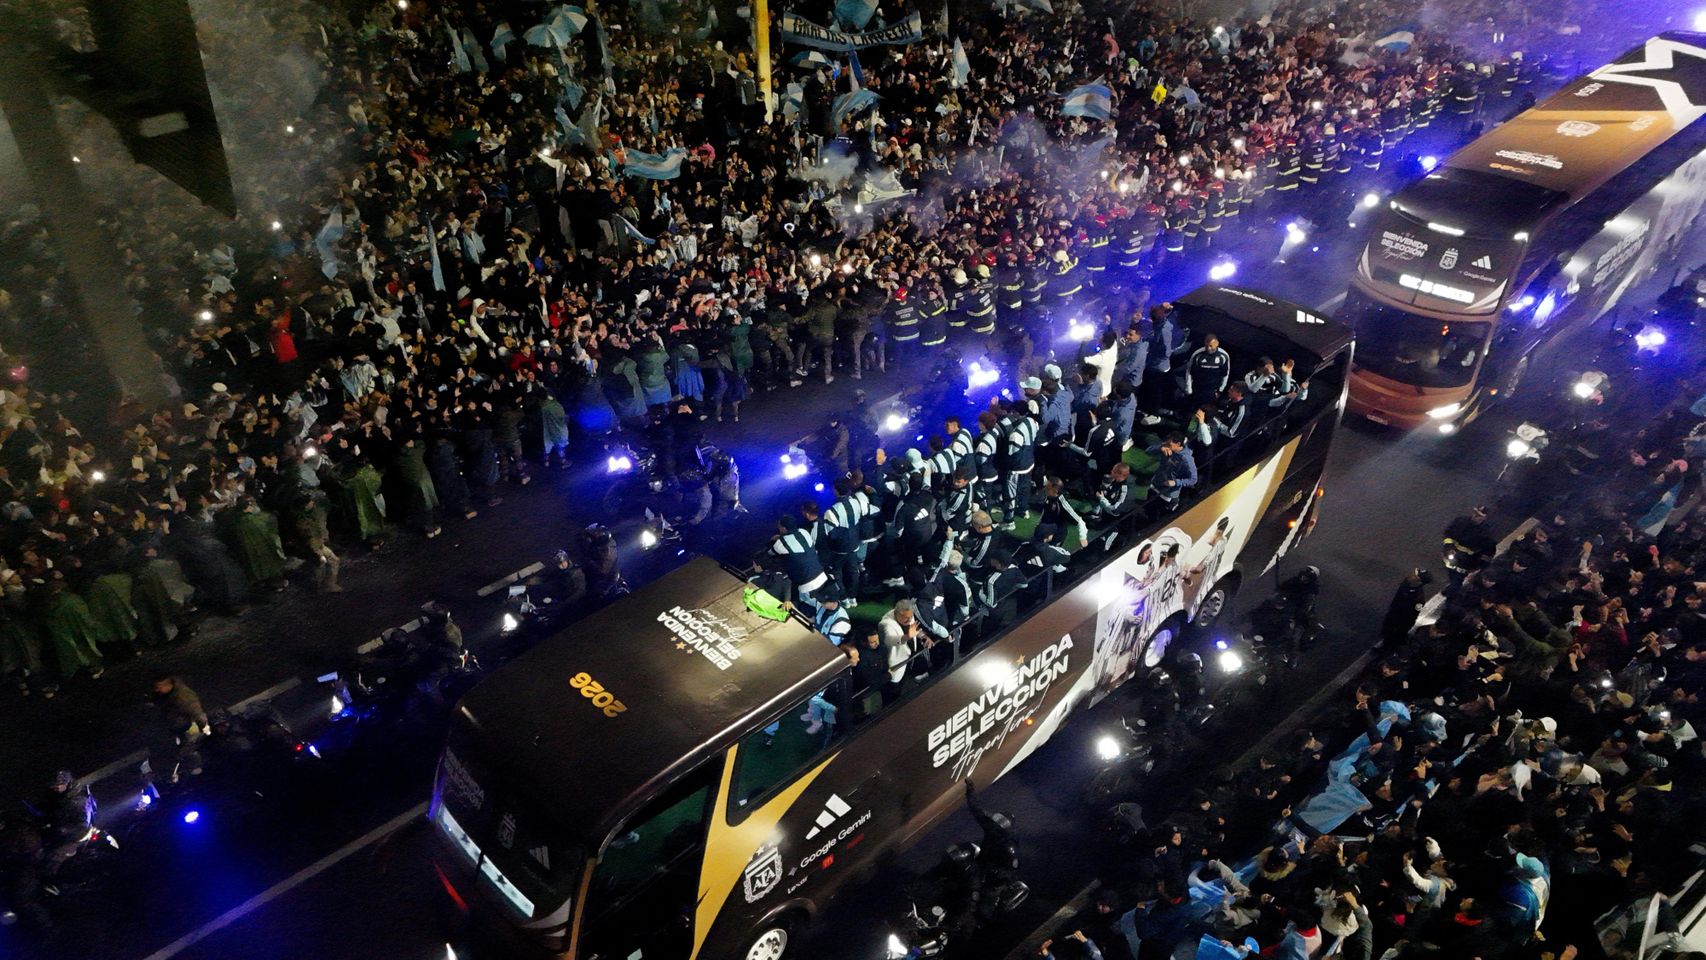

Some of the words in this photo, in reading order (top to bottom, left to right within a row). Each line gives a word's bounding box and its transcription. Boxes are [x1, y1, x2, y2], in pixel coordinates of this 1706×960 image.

[1382, 231, 1429, 252] BIENVENIDA
[656, 611, 733, 671] BIENVENIDA
[569, 672, 627, 718] 2026
[927, 633, 1074, 752] BIENVENIDA
[932, 655, 1069, 768] SELECCIÓN
[800, 838, 837, 868] Google
[838, 810, 872, 841] Gemini
[752, 866, 776, 892] AFA
